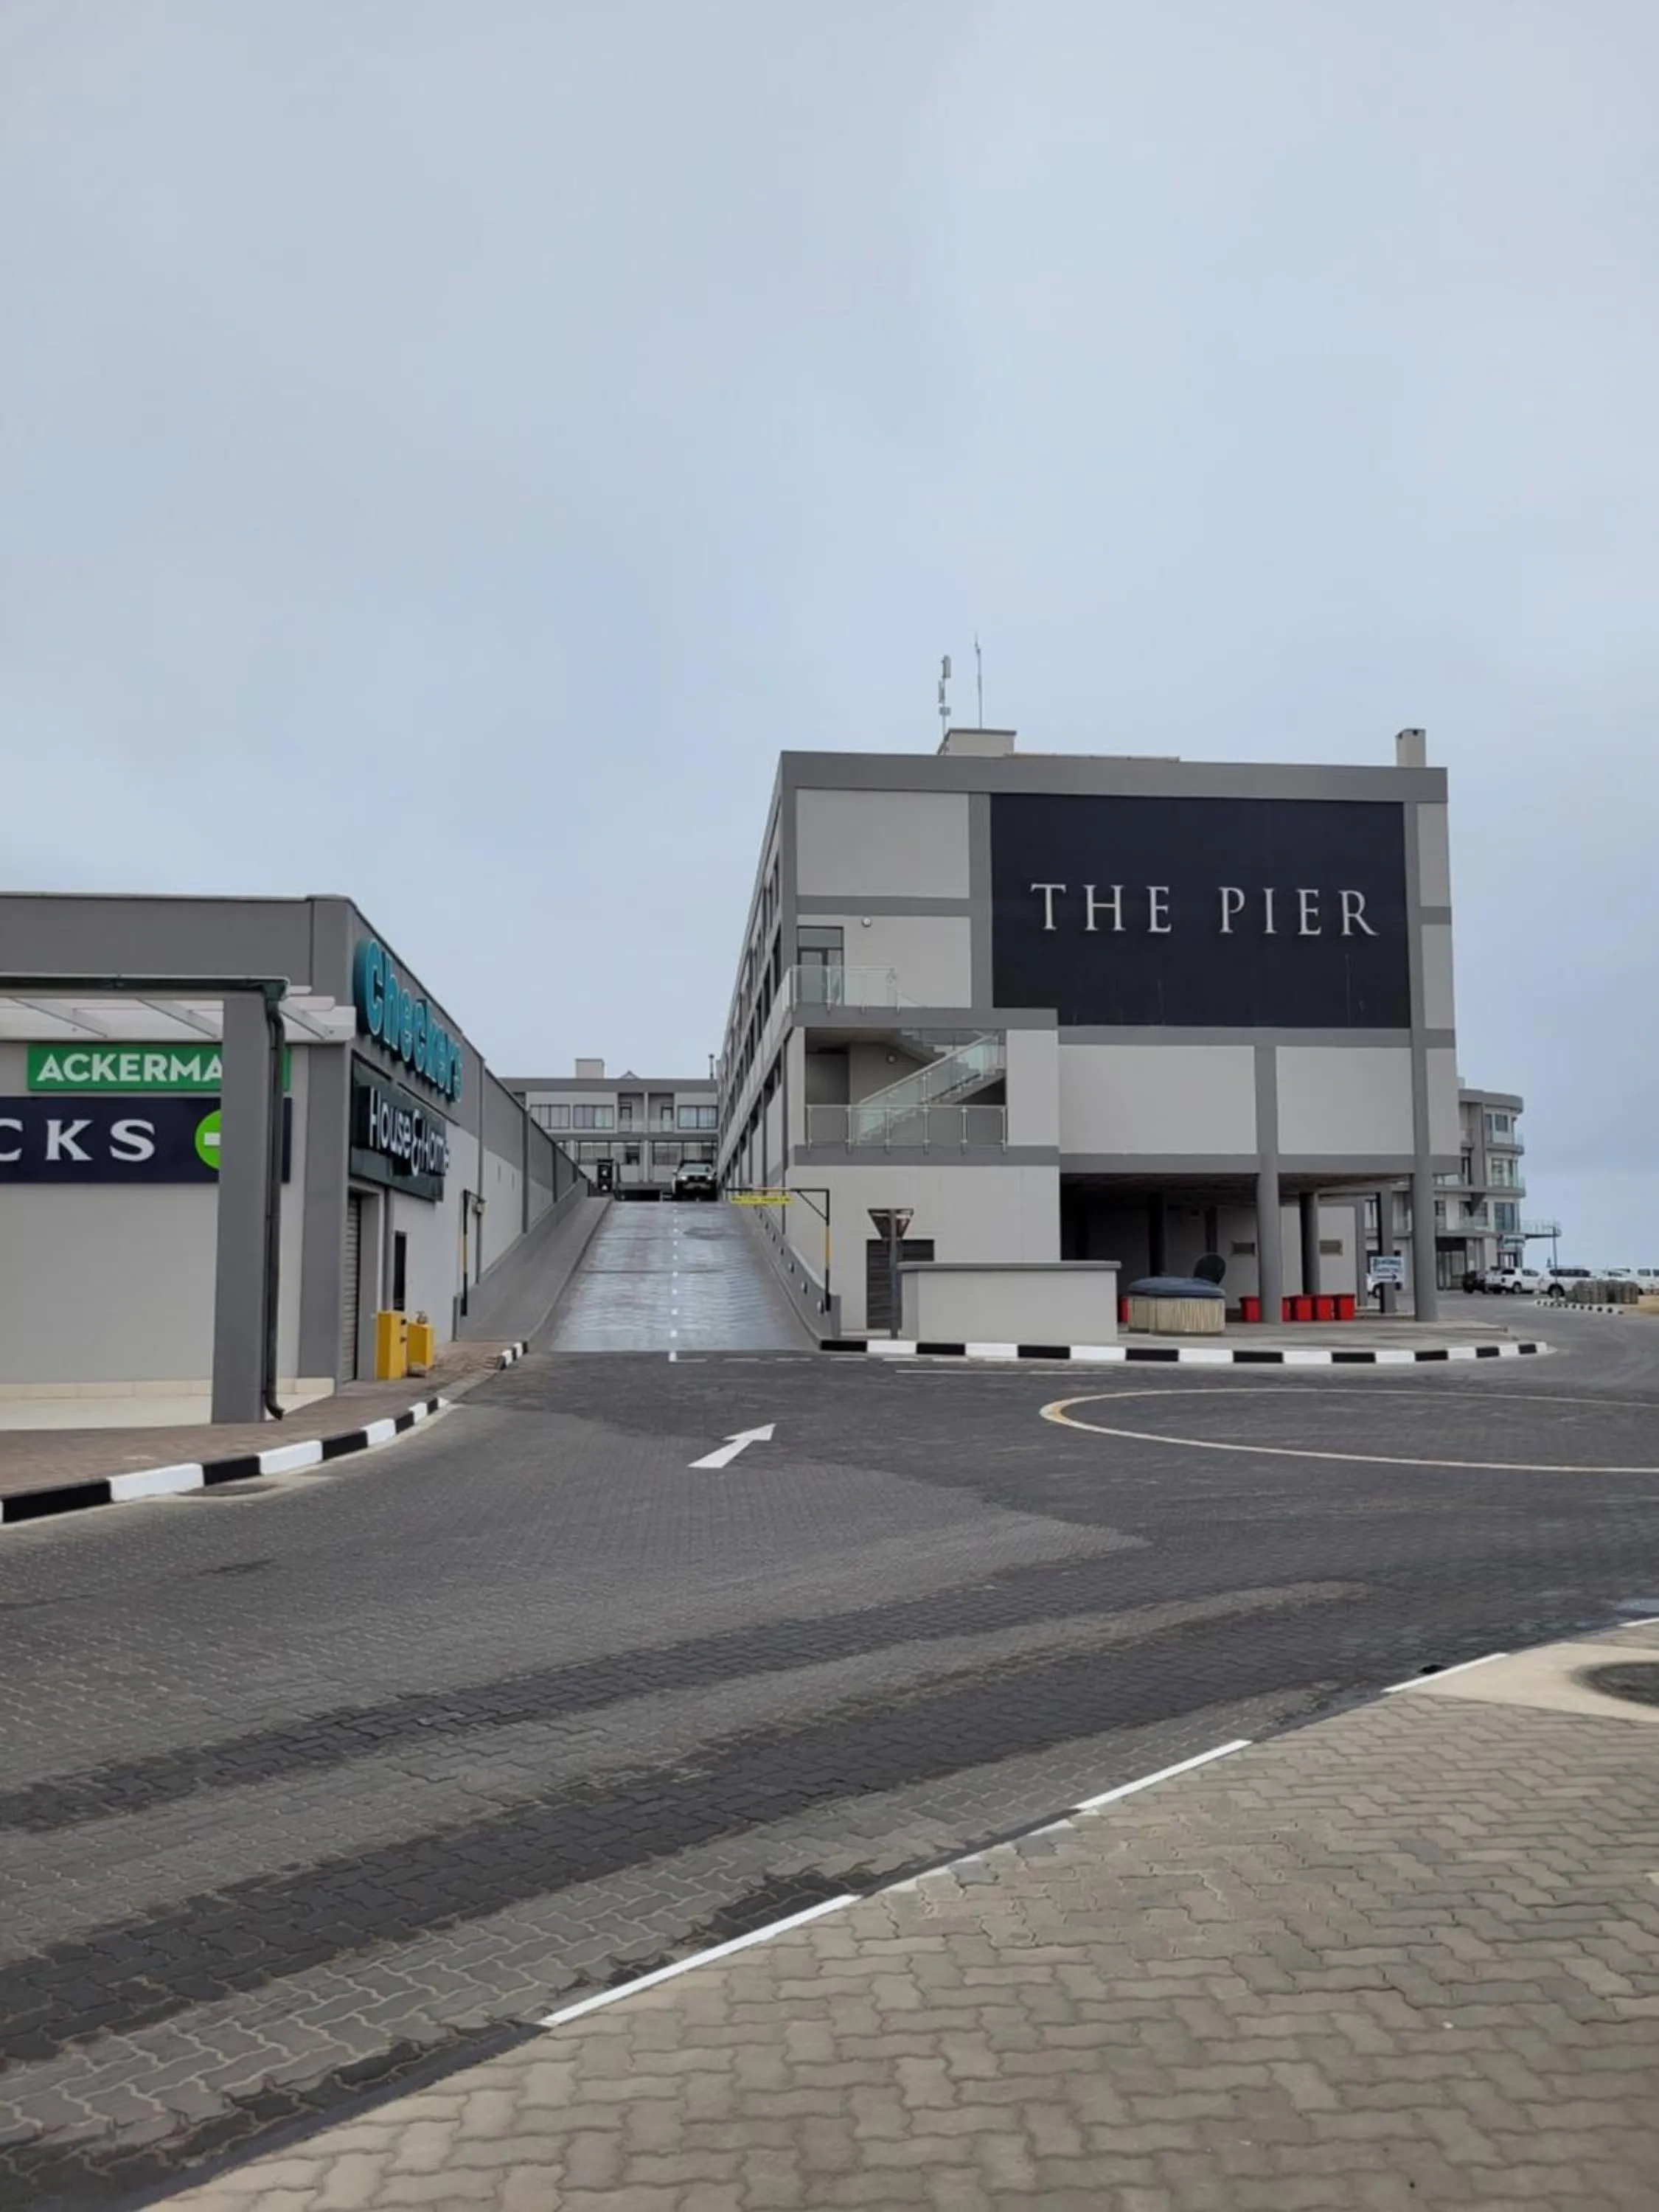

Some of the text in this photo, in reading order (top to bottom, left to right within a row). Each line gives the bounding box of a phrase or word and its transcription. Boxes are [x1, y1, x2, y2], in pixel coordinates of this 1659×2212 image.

[1031, 883, 1379, 936] THE PIER
[354, 937, 462, 1103] Checkers
